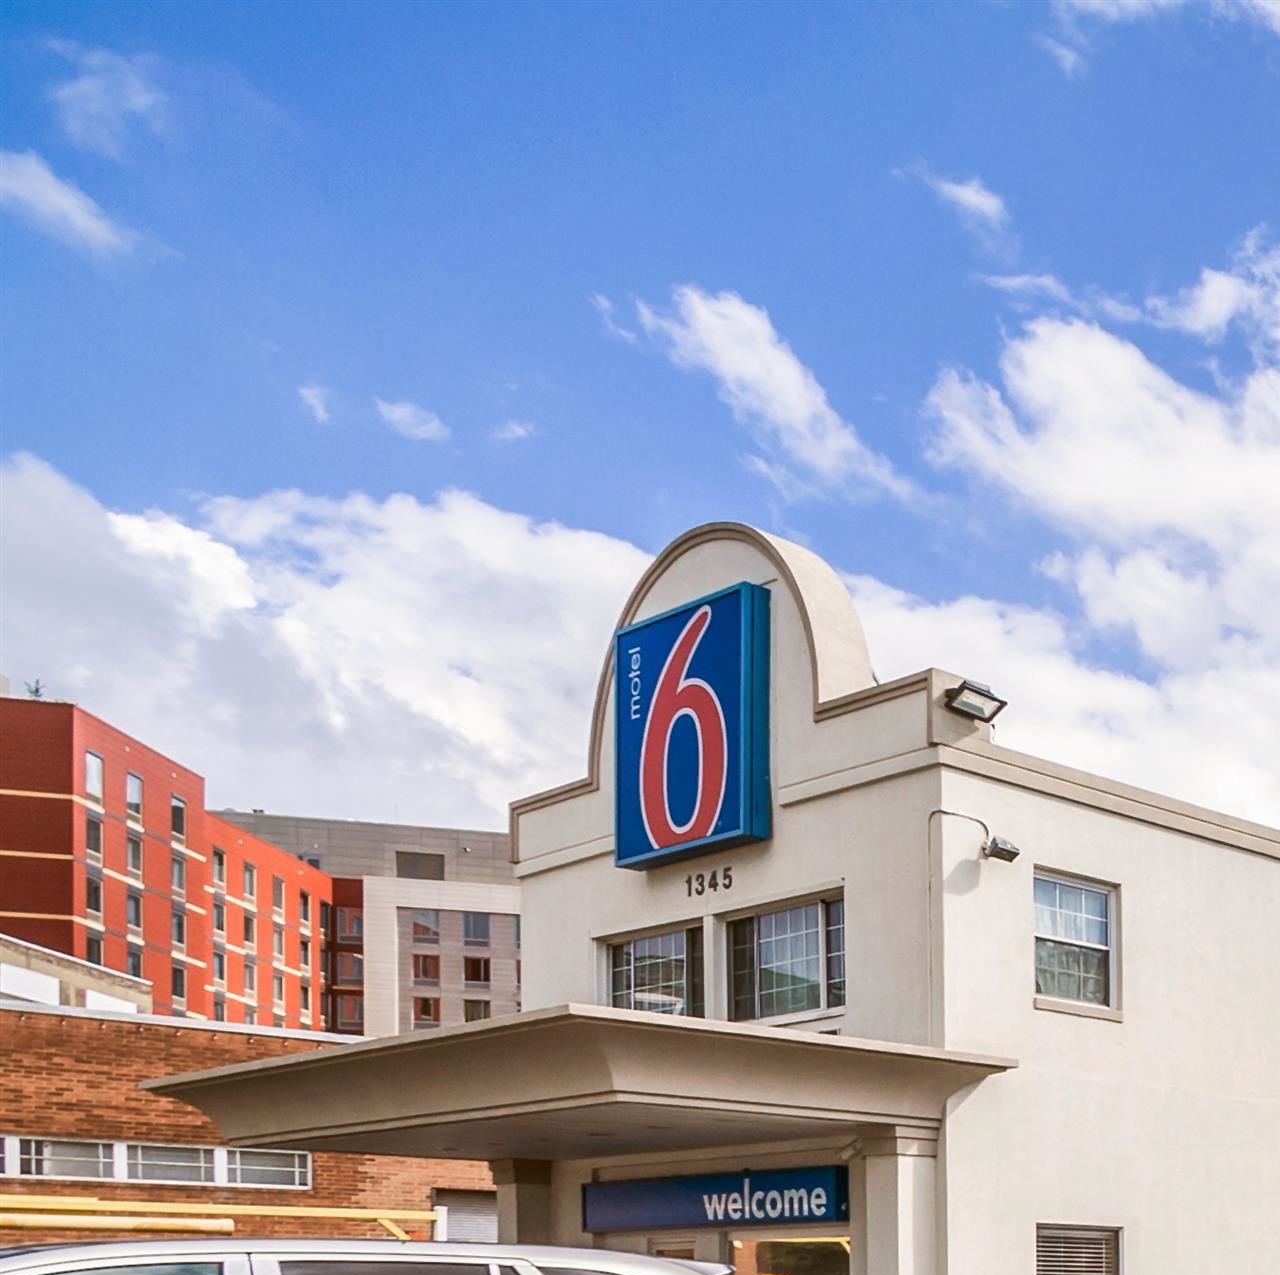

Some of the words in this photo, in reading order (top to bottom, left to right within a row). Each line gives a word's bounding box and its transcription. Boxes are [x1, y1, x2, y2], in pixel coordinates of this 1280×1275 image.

[628, 646, 641, 720] motel
[639, 604, 728, 849] 6
[684, 866, 733, 897] 1345
[703, 1178, 827, 1220] welcome
